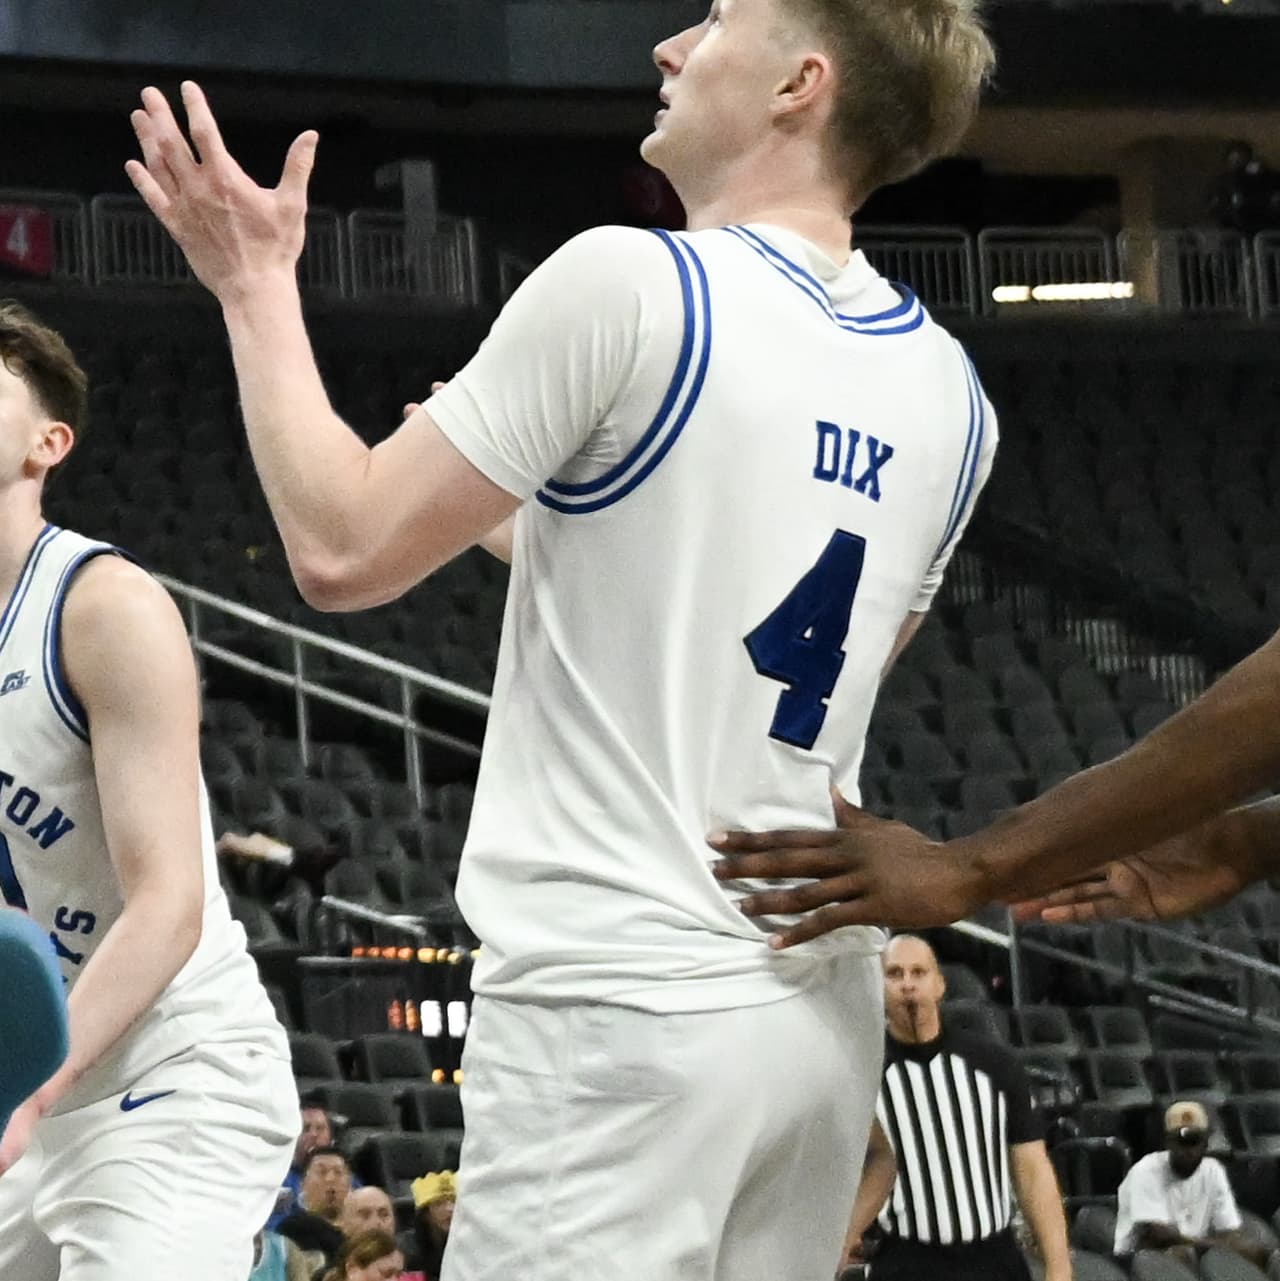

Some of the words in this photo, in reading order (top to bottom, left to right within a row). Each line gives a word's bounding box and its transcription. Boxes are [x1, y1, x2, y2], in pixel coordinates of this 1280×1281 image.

[6, 216, 31, 262] 4
[813, 420, 894, 503] DIX
[743, 528, 867, 751] 4
